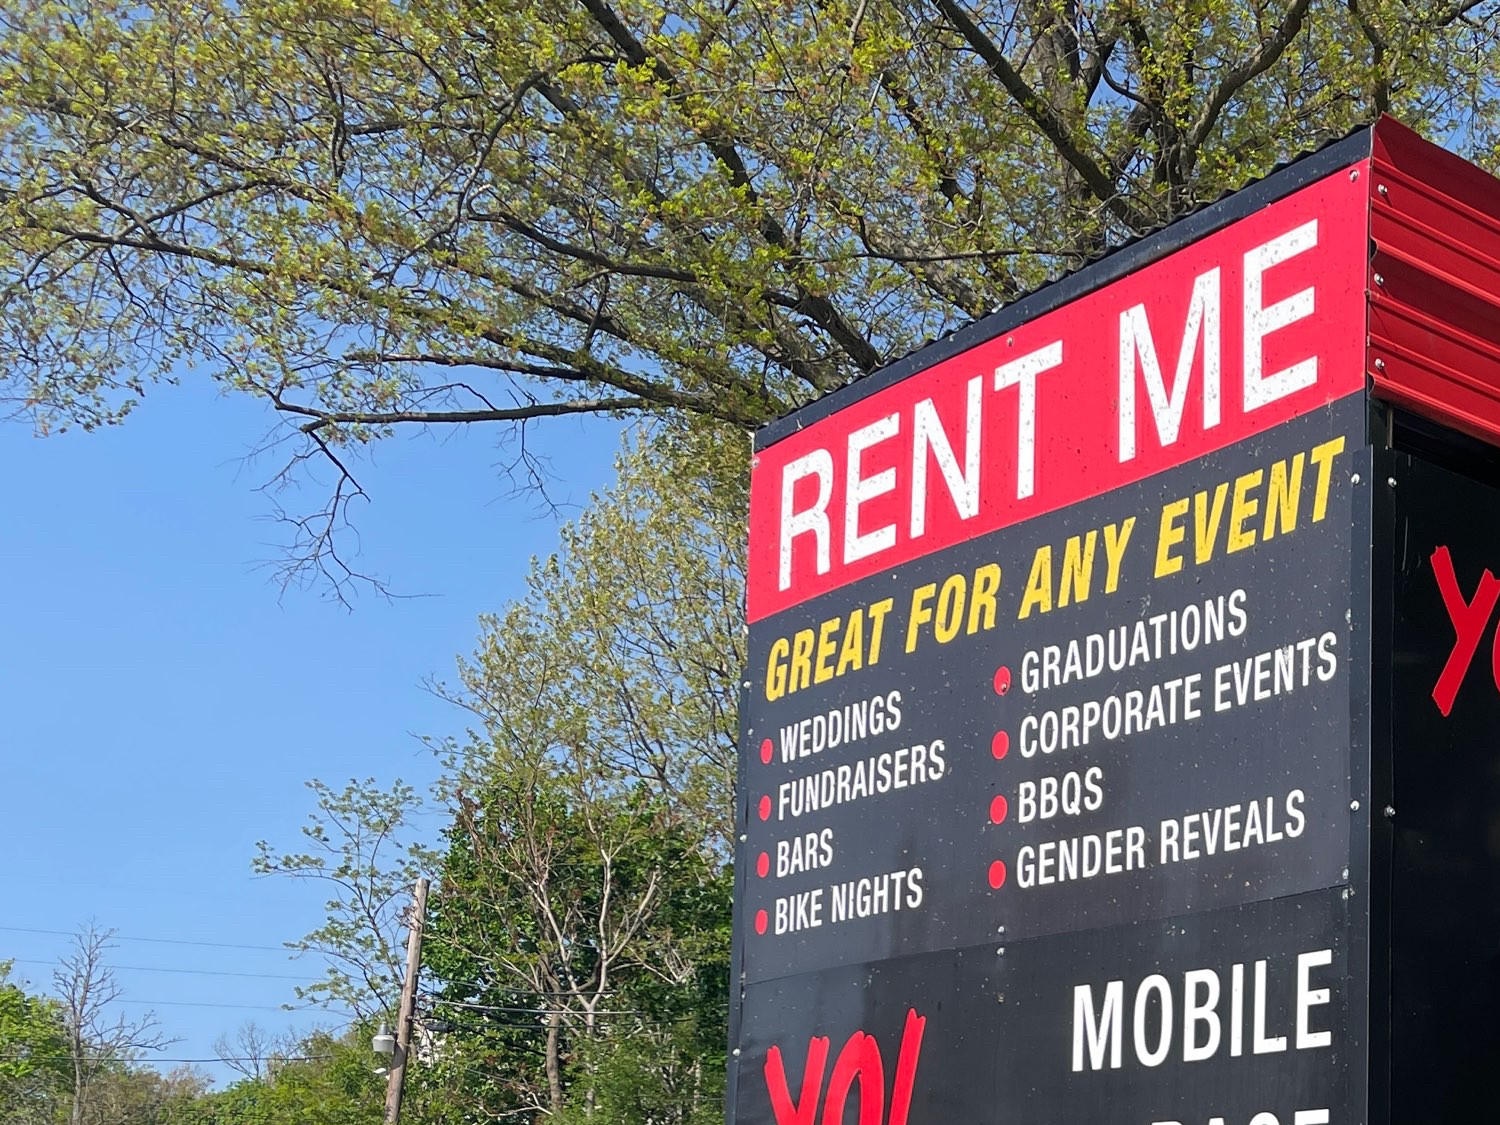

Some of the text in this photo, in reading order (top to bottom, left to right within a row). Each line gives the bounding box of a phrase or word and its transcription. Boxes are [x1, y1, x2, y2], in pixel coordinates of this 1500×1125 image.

[779, 219, 1317, 591] RENT ME
[765, 437, 1345, 701] GREAT FOR ANY EVENT
[1022, 589, 1247, 693] GRADUATIONS
[780, 691, 901, 763] WEDDINGS
[1020, 632, 1336, 758] CORPORATE EVENTS
[779, 740, 945, 820] FUNDRAISERS
[1019, 767, 1102, 823] BBQS
[777, 828, 833, 877] BARS
[1017, 790, 1305, 888] GENDER REVEALS
[775, 868, 922, 935] BIKE NIGHTS
[1072, 950, 1331, 1071] MOBILE
